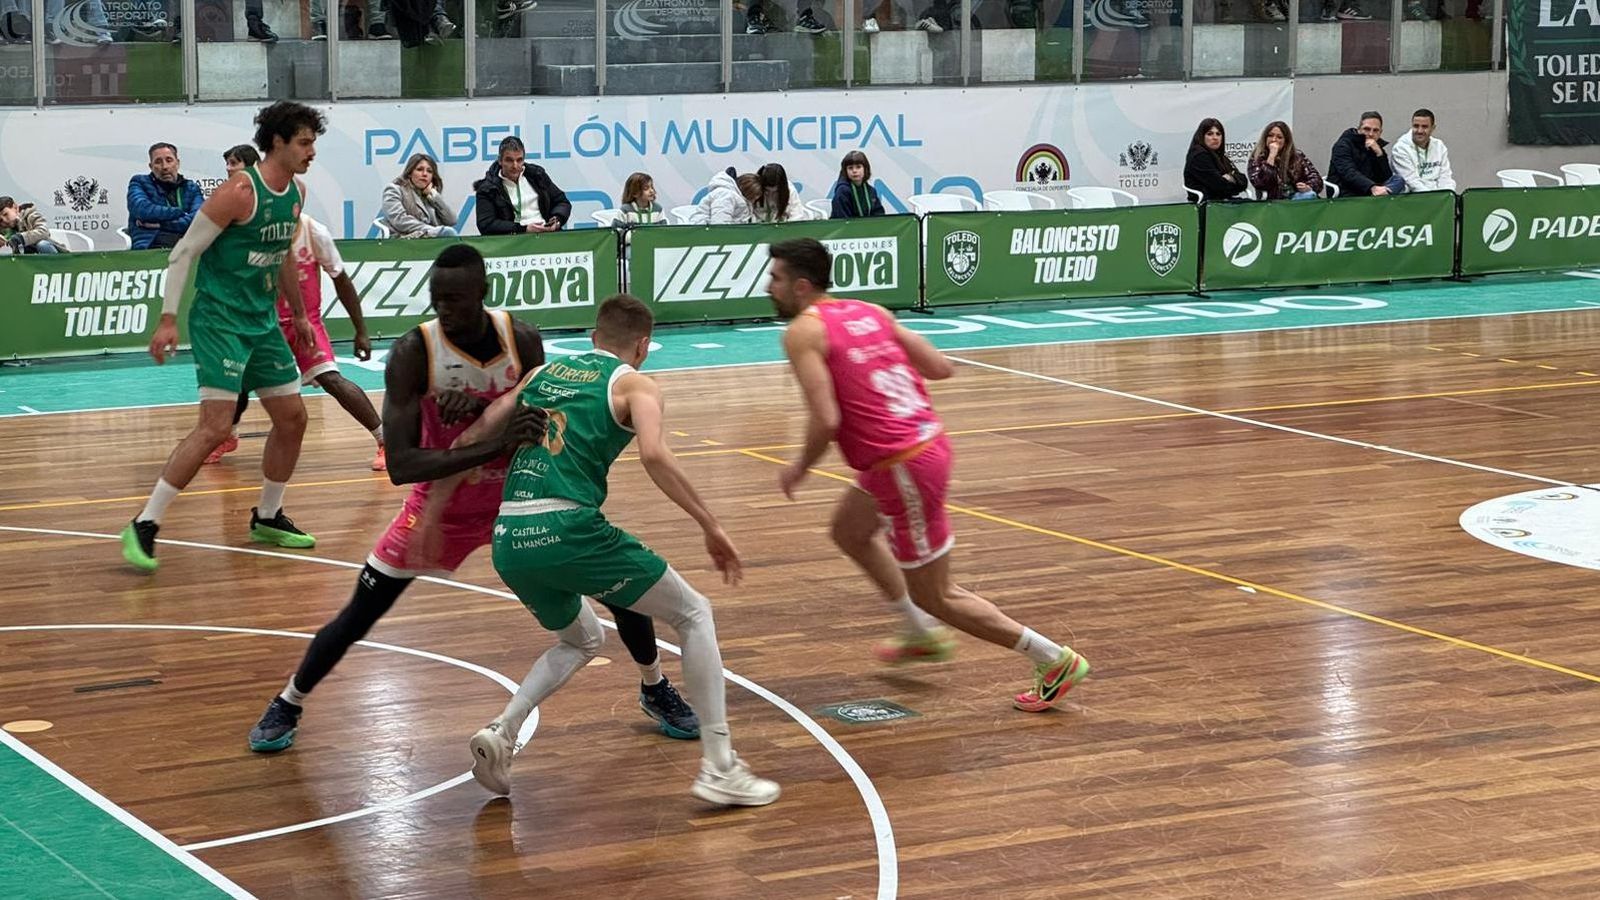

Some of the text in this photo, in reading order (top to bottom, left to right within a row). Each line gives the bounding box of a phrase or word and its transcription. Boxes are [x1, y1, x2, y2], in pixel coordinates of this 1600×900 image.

[1552, 82, 1579, 103] SE
[365, 113, 922, 165] PABELLÓN MUNICIPAL
[1119, 178, 1159, 188] TOLEDO
[54, 220, 110, 231] TOLEDO
[1149, 225, 1179, 238] TOLEDO
[946, 232, 978, 246] TOLEDO
[1010, 224, 1120, 255] BALONCESTO
[1273, 223, 1434, 255] PADECASA
[1034, 255, 1098, 284] TOLEDO
[64, 304, 149, 338] TOLEDO
[545, 362, 601, 382] MORENO
[511, 535, 562, 549] LA MANCHA
